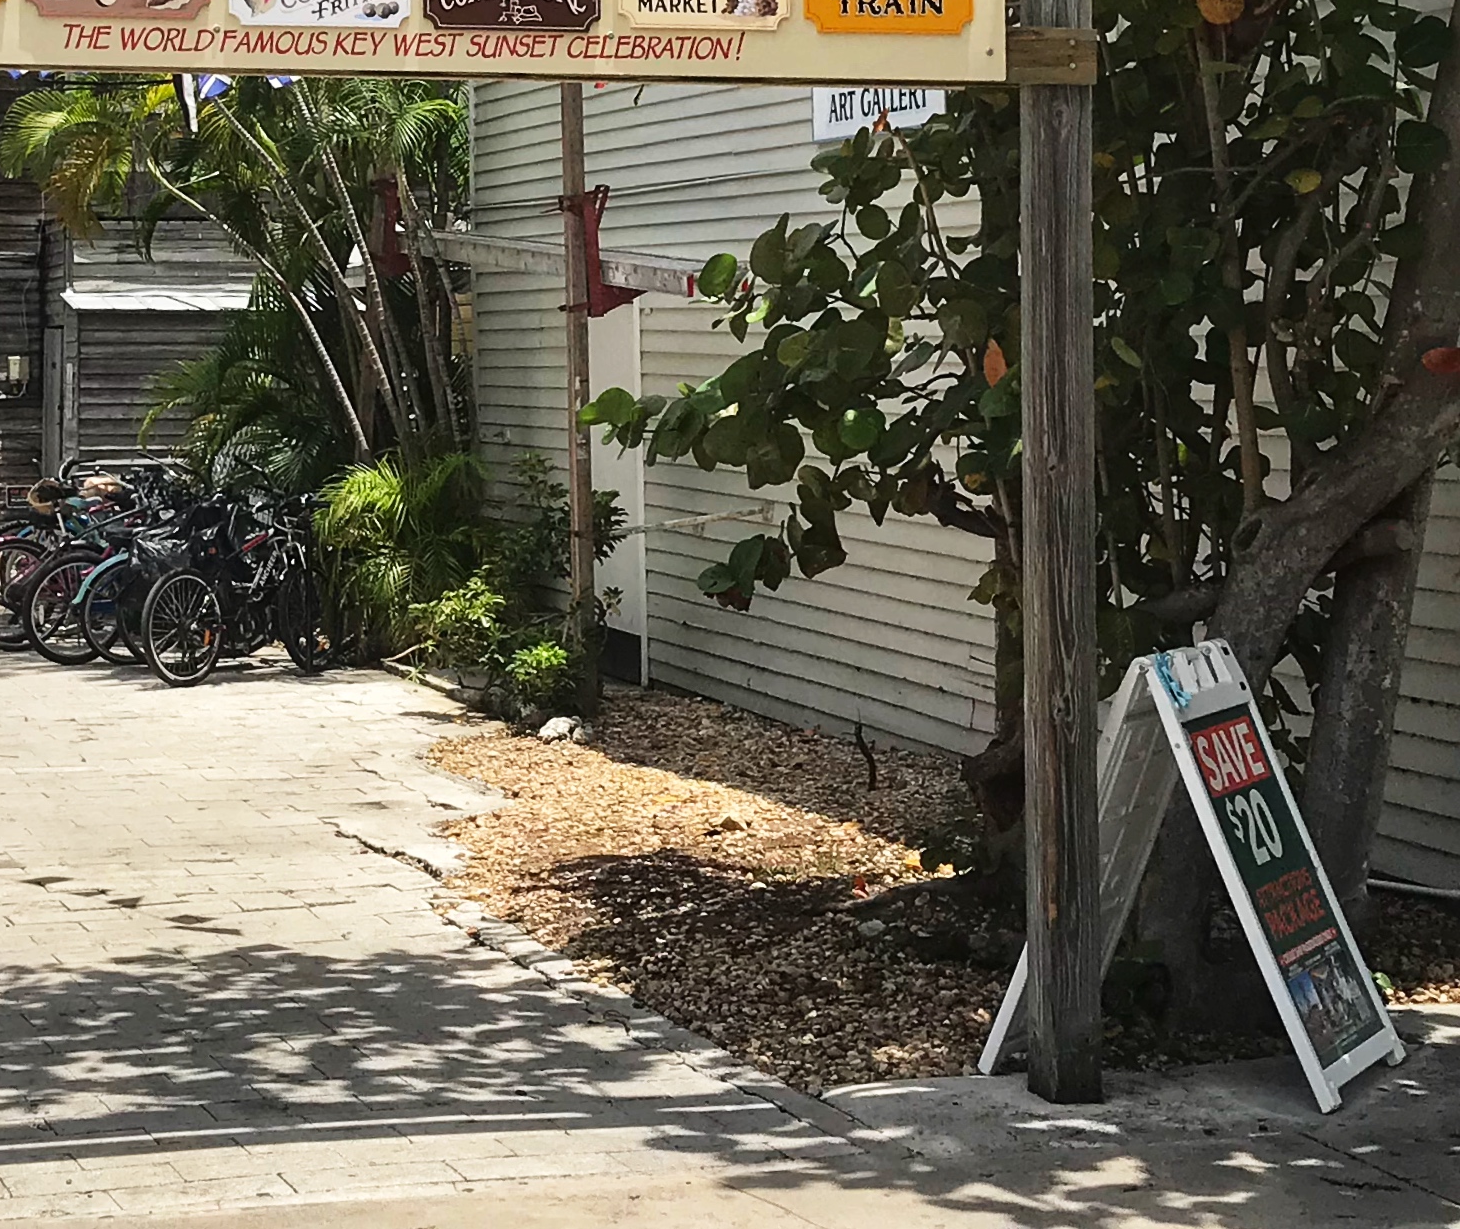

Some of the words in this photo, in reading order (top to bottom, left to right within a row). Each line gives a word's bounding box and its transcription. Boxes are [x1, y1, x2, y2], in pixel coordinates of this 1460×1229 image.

[61, 23, 111, 51] THE
[121, 26, 215, 53] WORLD
[219, 29, 329, 56] FAMOUS
[332, 29, 385, 57] KEY
[393, 31, 464, 59] WEST
[465, 32, 566, 60] SUNSET
[566, 31, 745, 62] CELEBRATION!
[828, 90, 856, 124] ART
[1196, 722, 1266, 793] SAVE
[1224, 788, 1284, 866] $20
